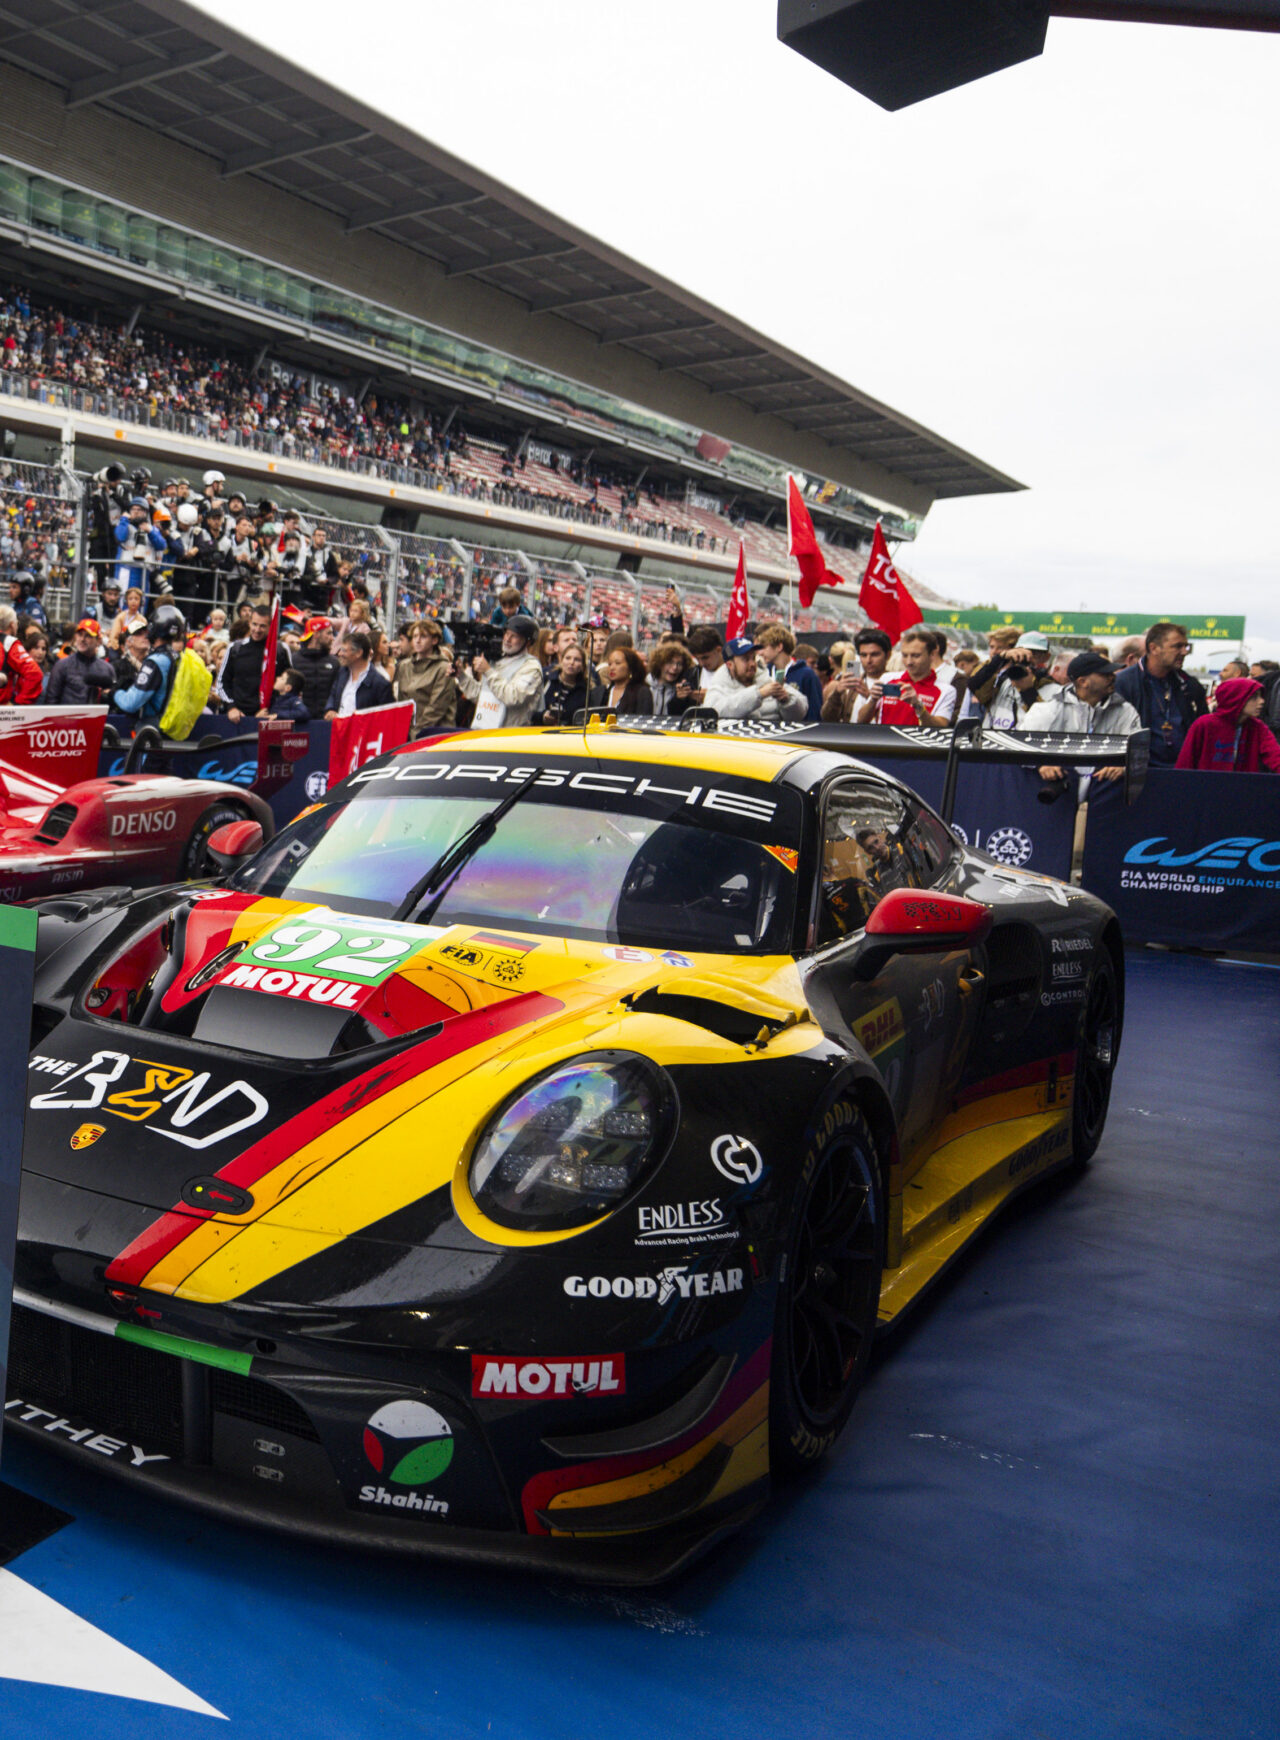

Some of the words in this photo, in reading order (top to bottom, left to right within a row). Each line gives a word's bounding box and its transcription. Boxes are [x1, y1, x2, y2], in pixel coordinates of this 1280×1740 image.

[27, 729, 87, 749] TOYOTA
[28, 749, 87, 759] RACING
[346, 763, 778, 823] PORSCHE
[111, 810, 177, 837] DENSO
[1120, 879, 1225, 895] CHAMPIONSHIP
[1121, 870, 1143, 880] FIA
[1146, 872, 1196, 884] WORLD
[1199, 875, 1280, 889] ENDURANCE
[251, 926, 413, 978] 92
[1052, 962, 1082, 976] ENDLESS
[220, 965, 365, 1008] MOTUL
[28, 1055, 79, 1076] THE
[638, 1197, 724, 1231] ENDLESS
[634, 1236, 667, 1247] Advanced
[667, 1236, 690, 1246] Racing
[689, 1234, 707, 1244] Brake
[707, 1231, 740, 1242] Technology
[479, 1360, 620, 1396] MOTUL
[358, 1484, 449, 1513] Shahin
